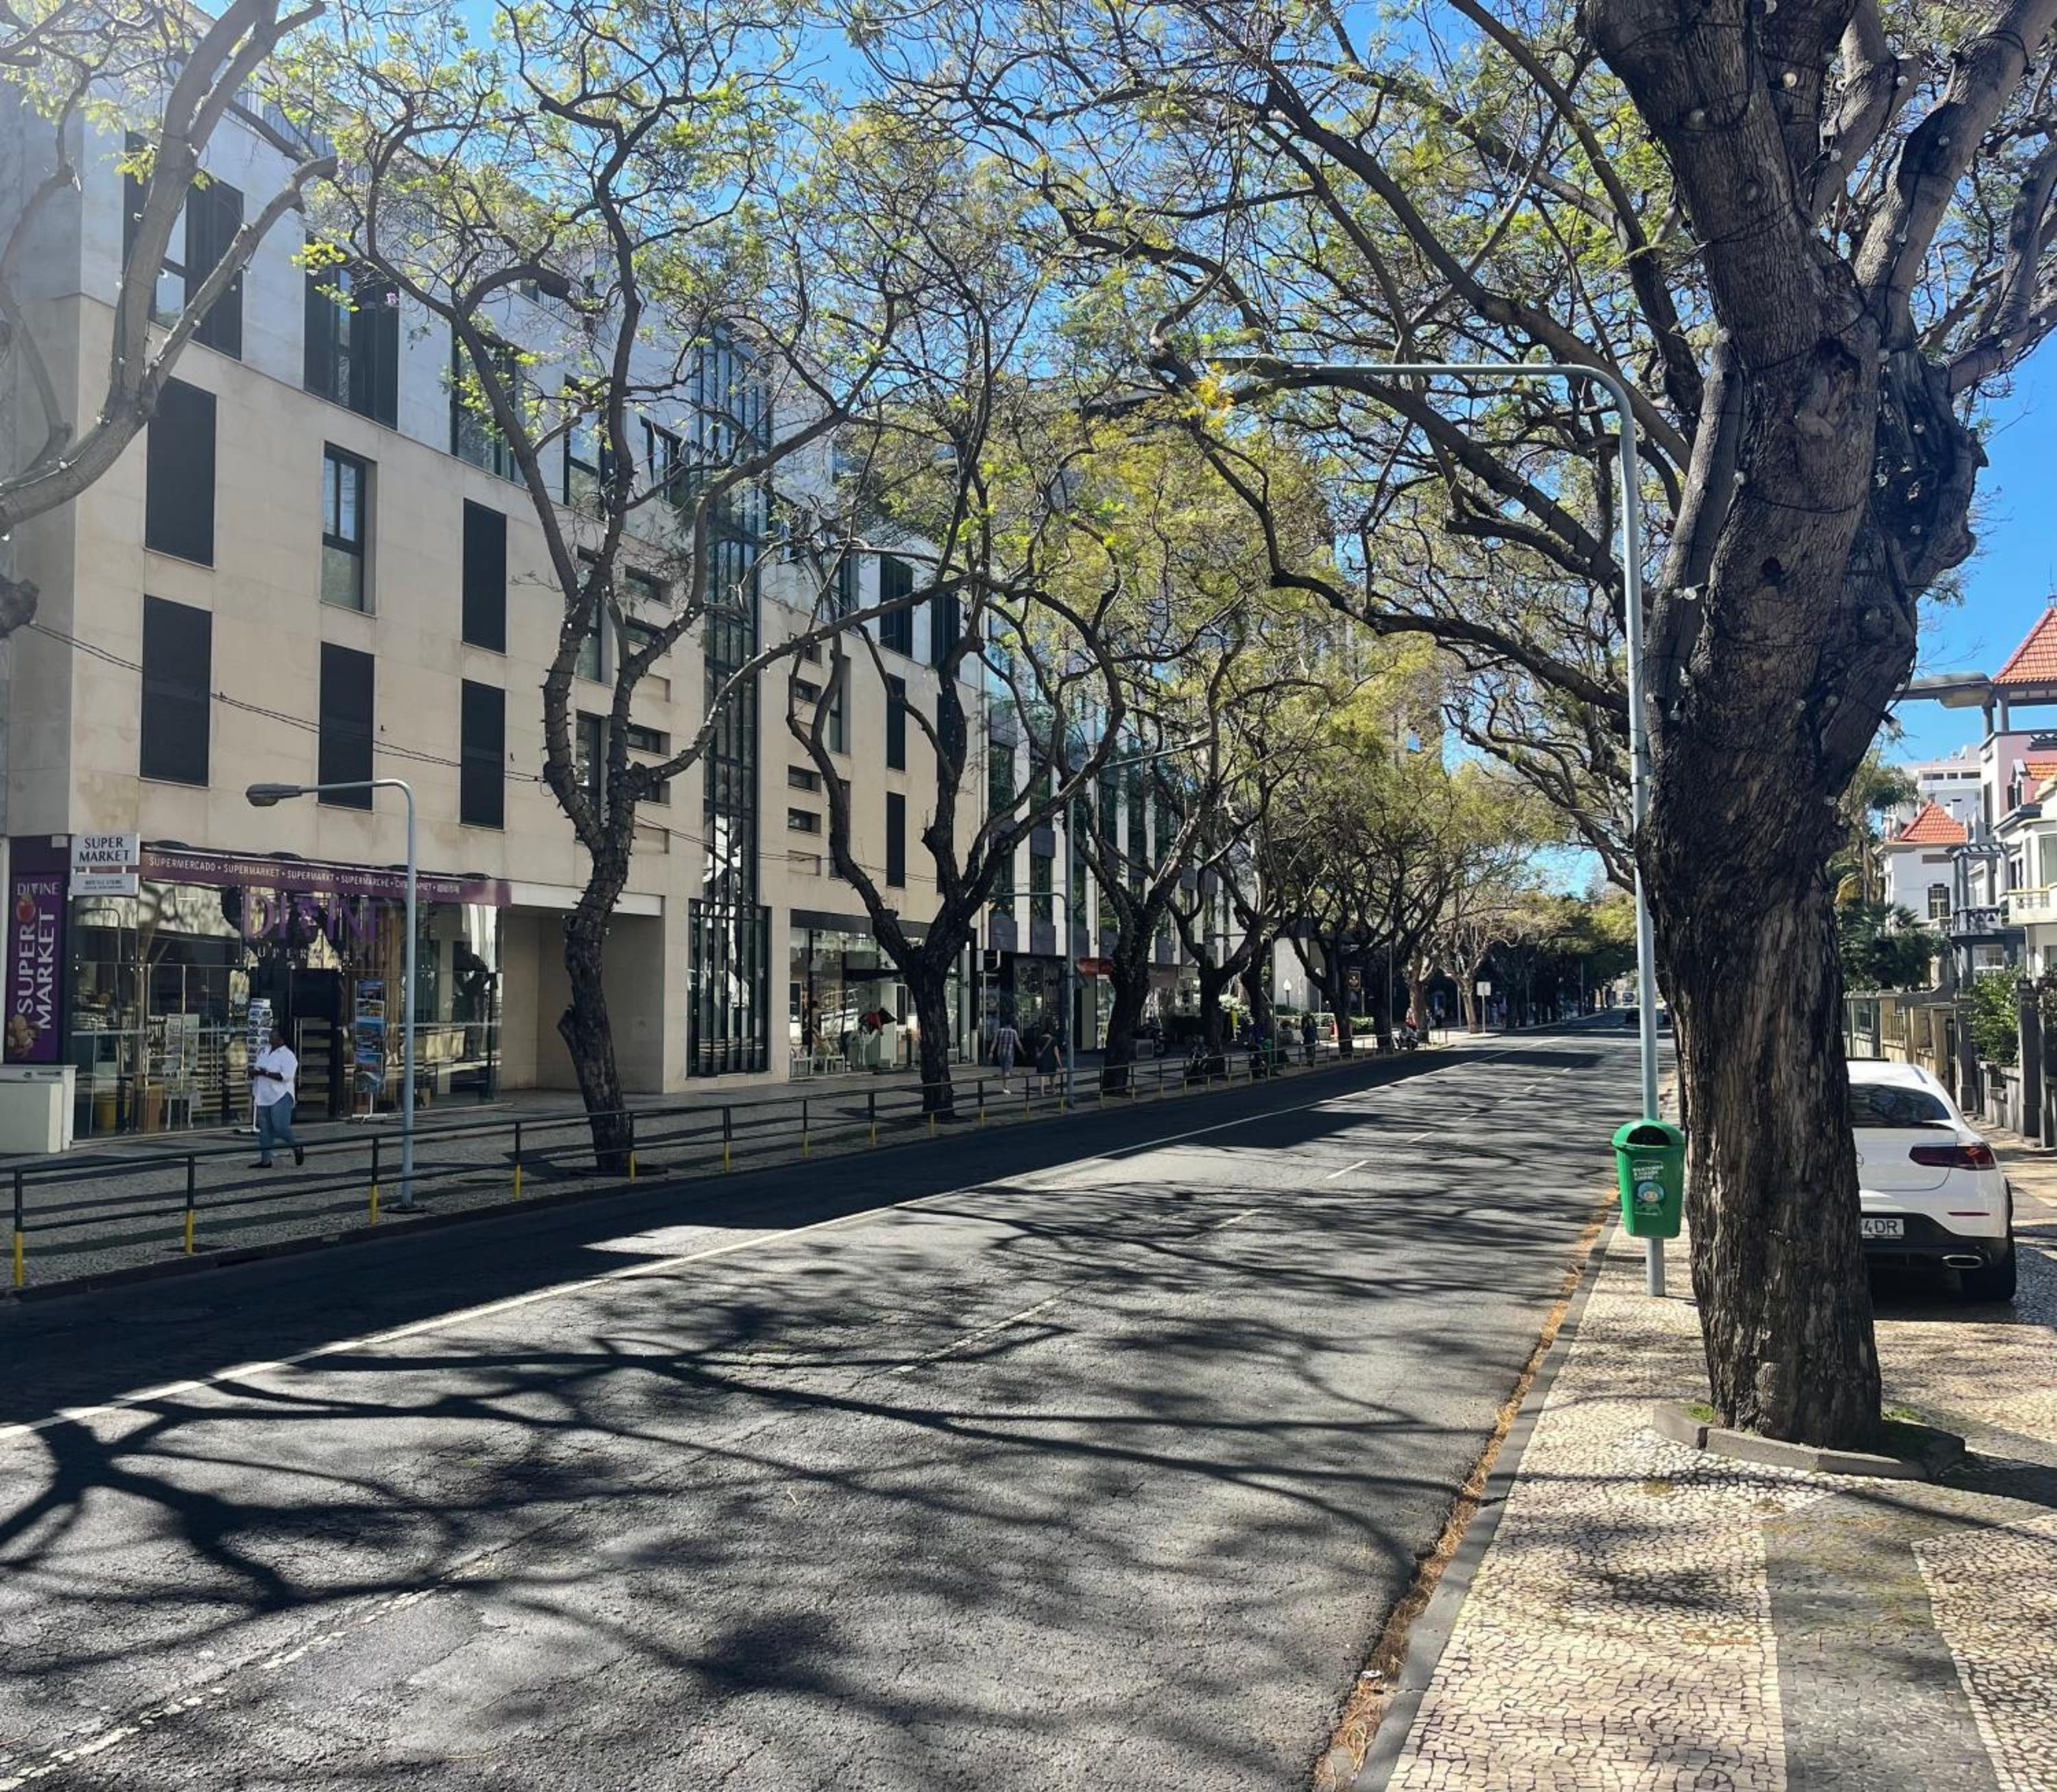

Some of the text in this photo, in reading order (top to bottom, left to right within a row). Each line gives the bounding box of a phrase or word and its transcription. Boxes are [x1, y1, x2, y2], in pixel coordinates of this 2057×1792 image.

[84, 837, 123, 849] SUPER
[79, 850, 130, 862] MARKET
[149, 856, 216, 871] SUPERMERCADO
[224, 864, 280, 877] SUPERMARKET
[287, 870, 334, 882] SUPERMARKT
[17, 882, 59, 896] DIVINE
[17, 924, 35, 1014] SUPER
[36, 907, 56, 1029] MARKET
